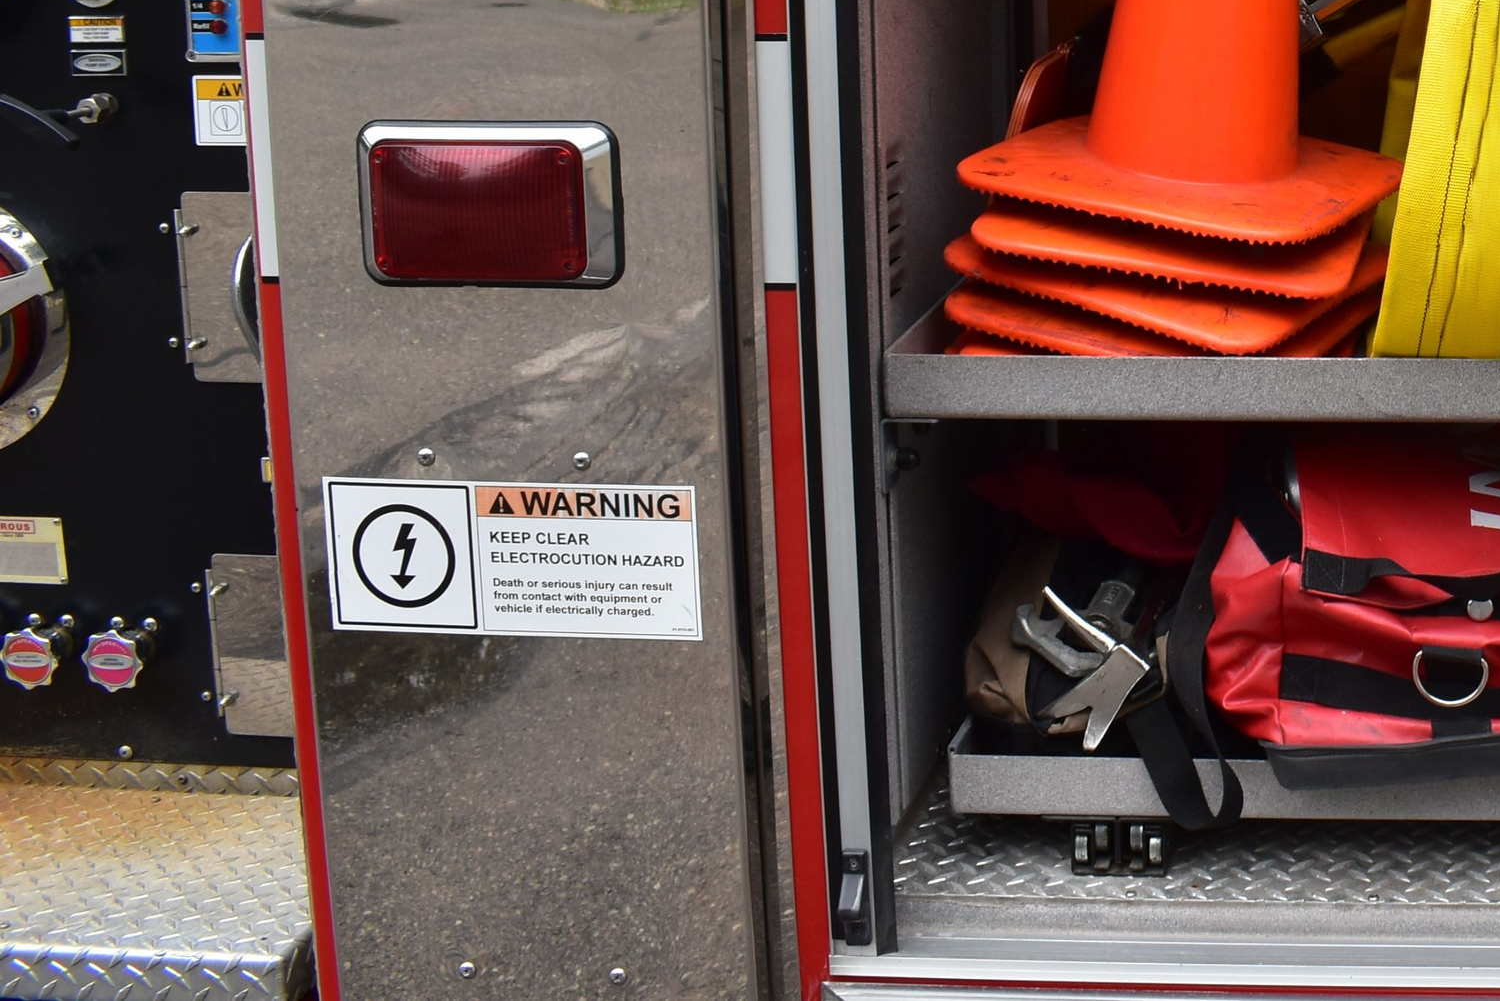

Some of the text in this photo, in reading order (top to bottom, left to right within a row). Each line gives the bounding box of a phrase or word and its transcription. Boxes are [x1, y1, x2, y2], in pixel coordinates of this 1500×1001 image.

[520, 491, 681, 518] WARNING
[0, 523, 30, 531] ROUS
[489, 531, 590, 545] KEEP CLEAR
[491, 551, 685, 567] ELECTROCUTION HAZARD
[493, 577, 673, 591] Death or serious injury can result
[493, 591, 662, 605] from contact with equipment or
[494, 604, 655, 617] vehicle if electrically charged.
